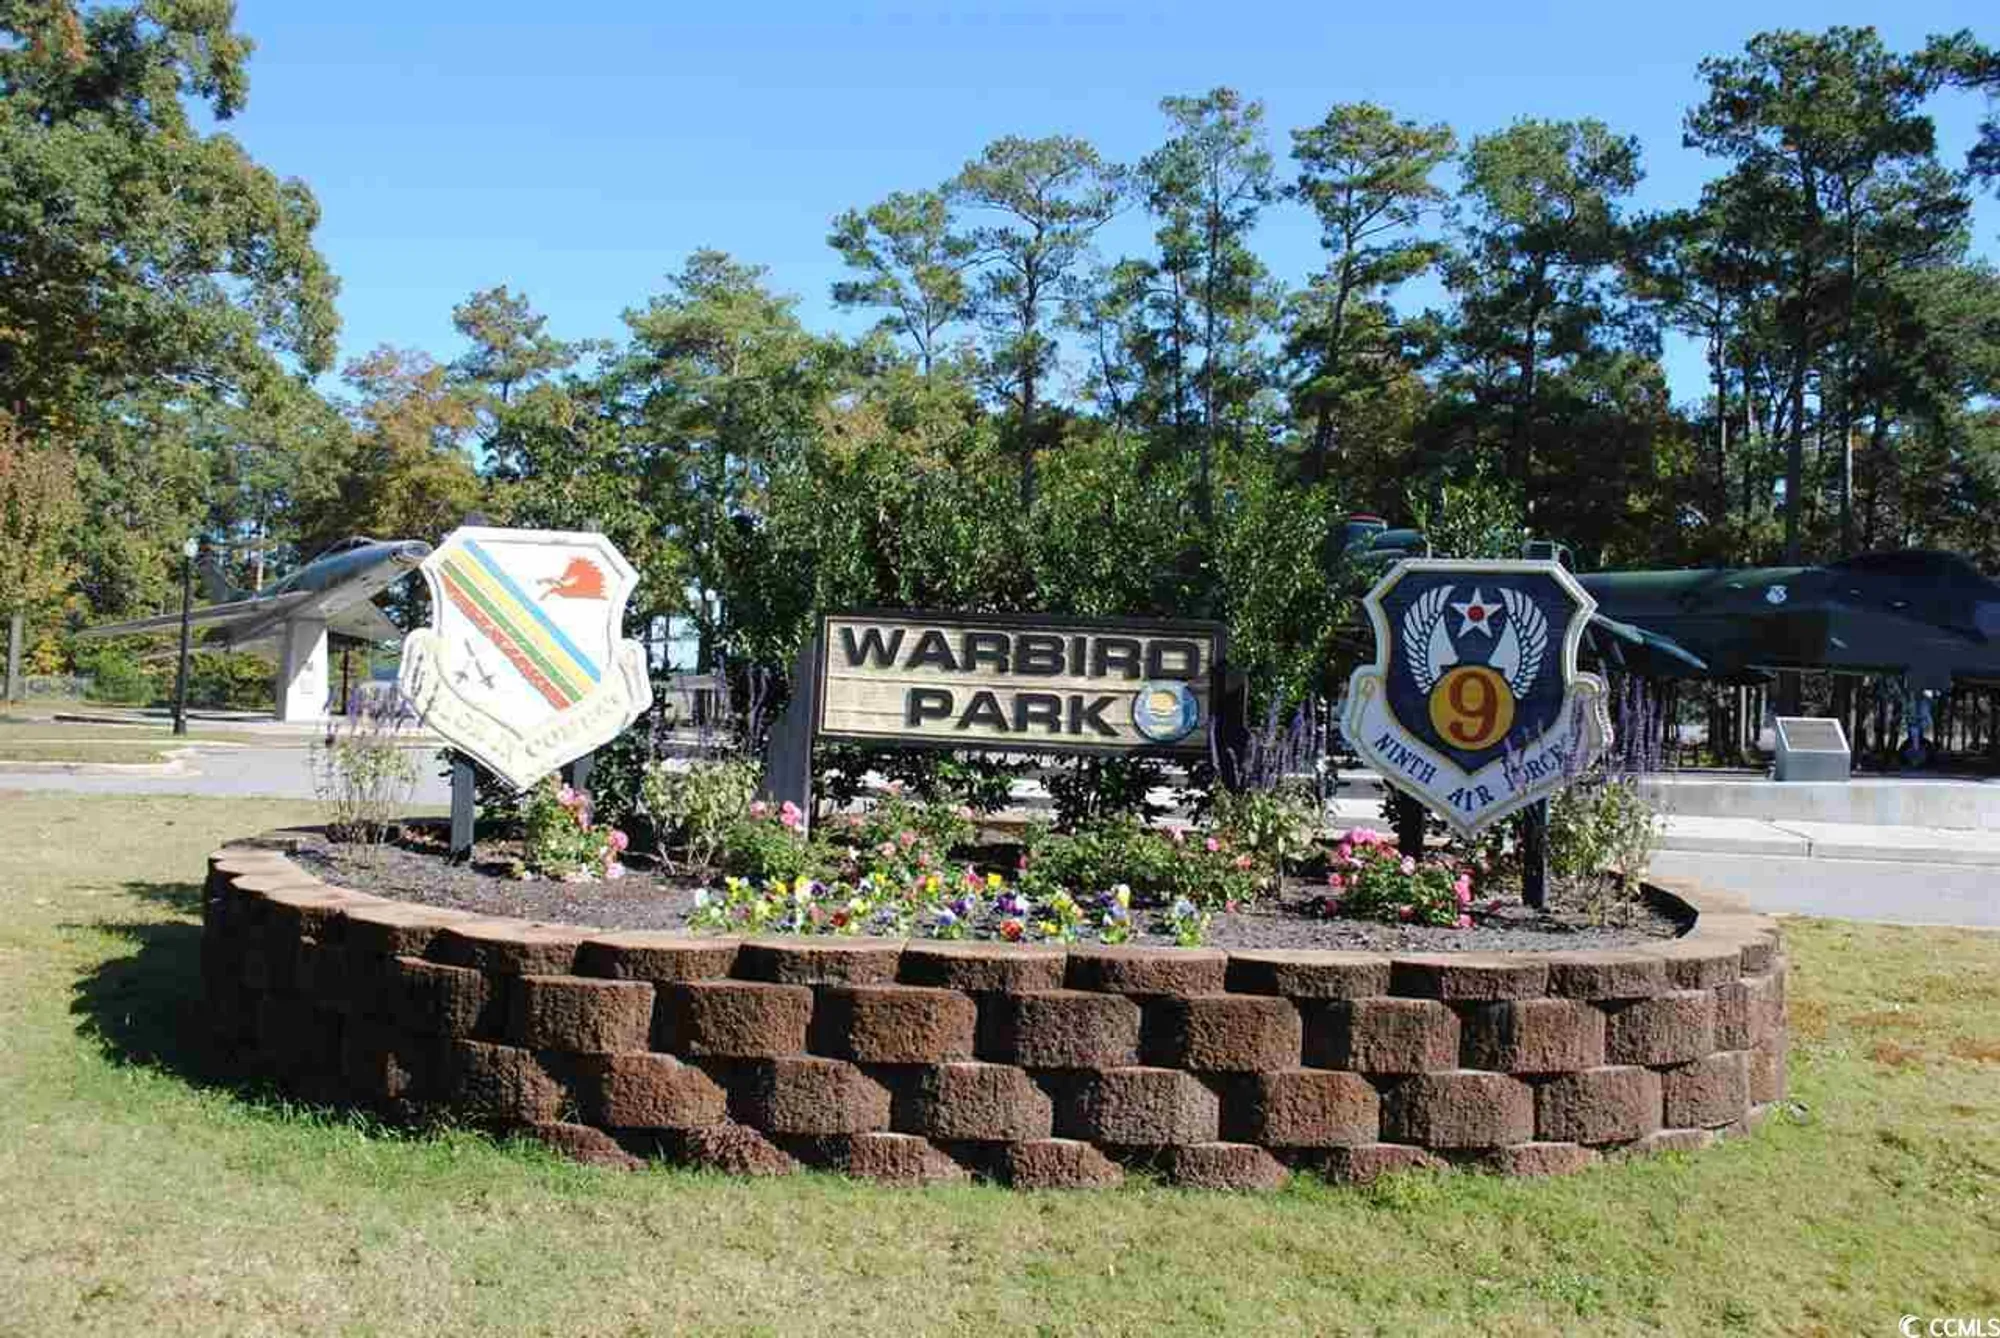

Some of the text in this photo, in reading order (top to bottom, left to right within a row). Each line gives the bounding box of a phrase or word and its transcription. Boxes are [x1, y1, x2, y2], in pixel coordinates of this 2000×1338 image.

[841, 625, 1200, 681] WARBIRD
[904, 686, 1122, 737] PARK
[1448, 672, 1501, 743] 9
[1374, 732, 1438, 785] NINTH
[1446, 784, 1496, 812] AIR
